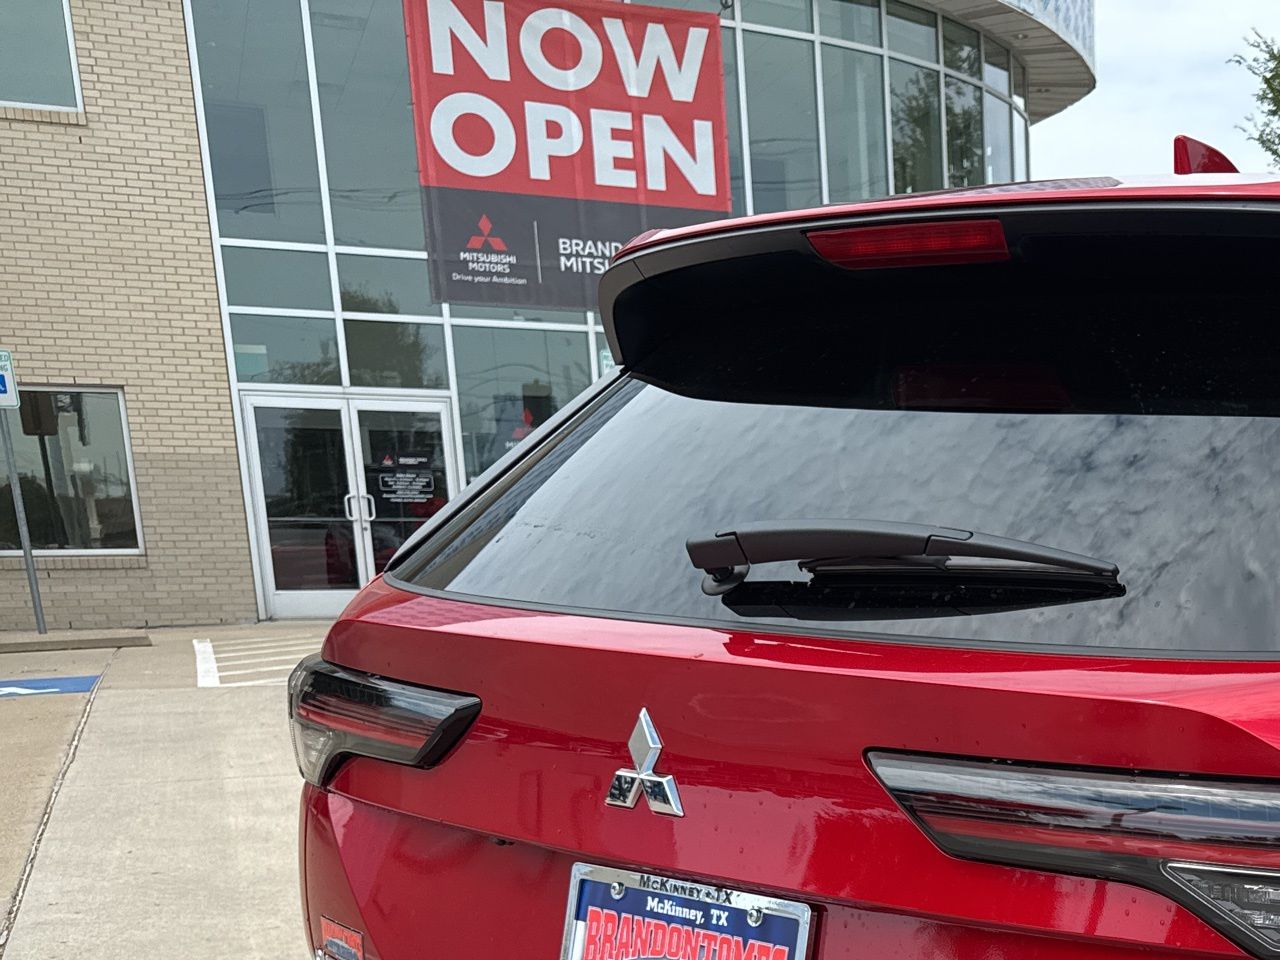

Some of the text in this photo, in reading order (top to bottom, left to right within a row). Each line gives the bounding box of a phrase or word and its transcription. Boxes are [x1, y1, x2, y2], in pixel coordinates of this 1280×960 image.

[427, 0, 709, 102] NOW
[430, 92, 717, 196] OPEN
[460, 251, 517, 264] MITSUBISHI
[468, 262, 511, 274] MOTORS
[452, 272, 527, 285] Drive your Ambition
[714, 887, 733, 904] TX
[646, 896, 729, 926] McKinney, TX
